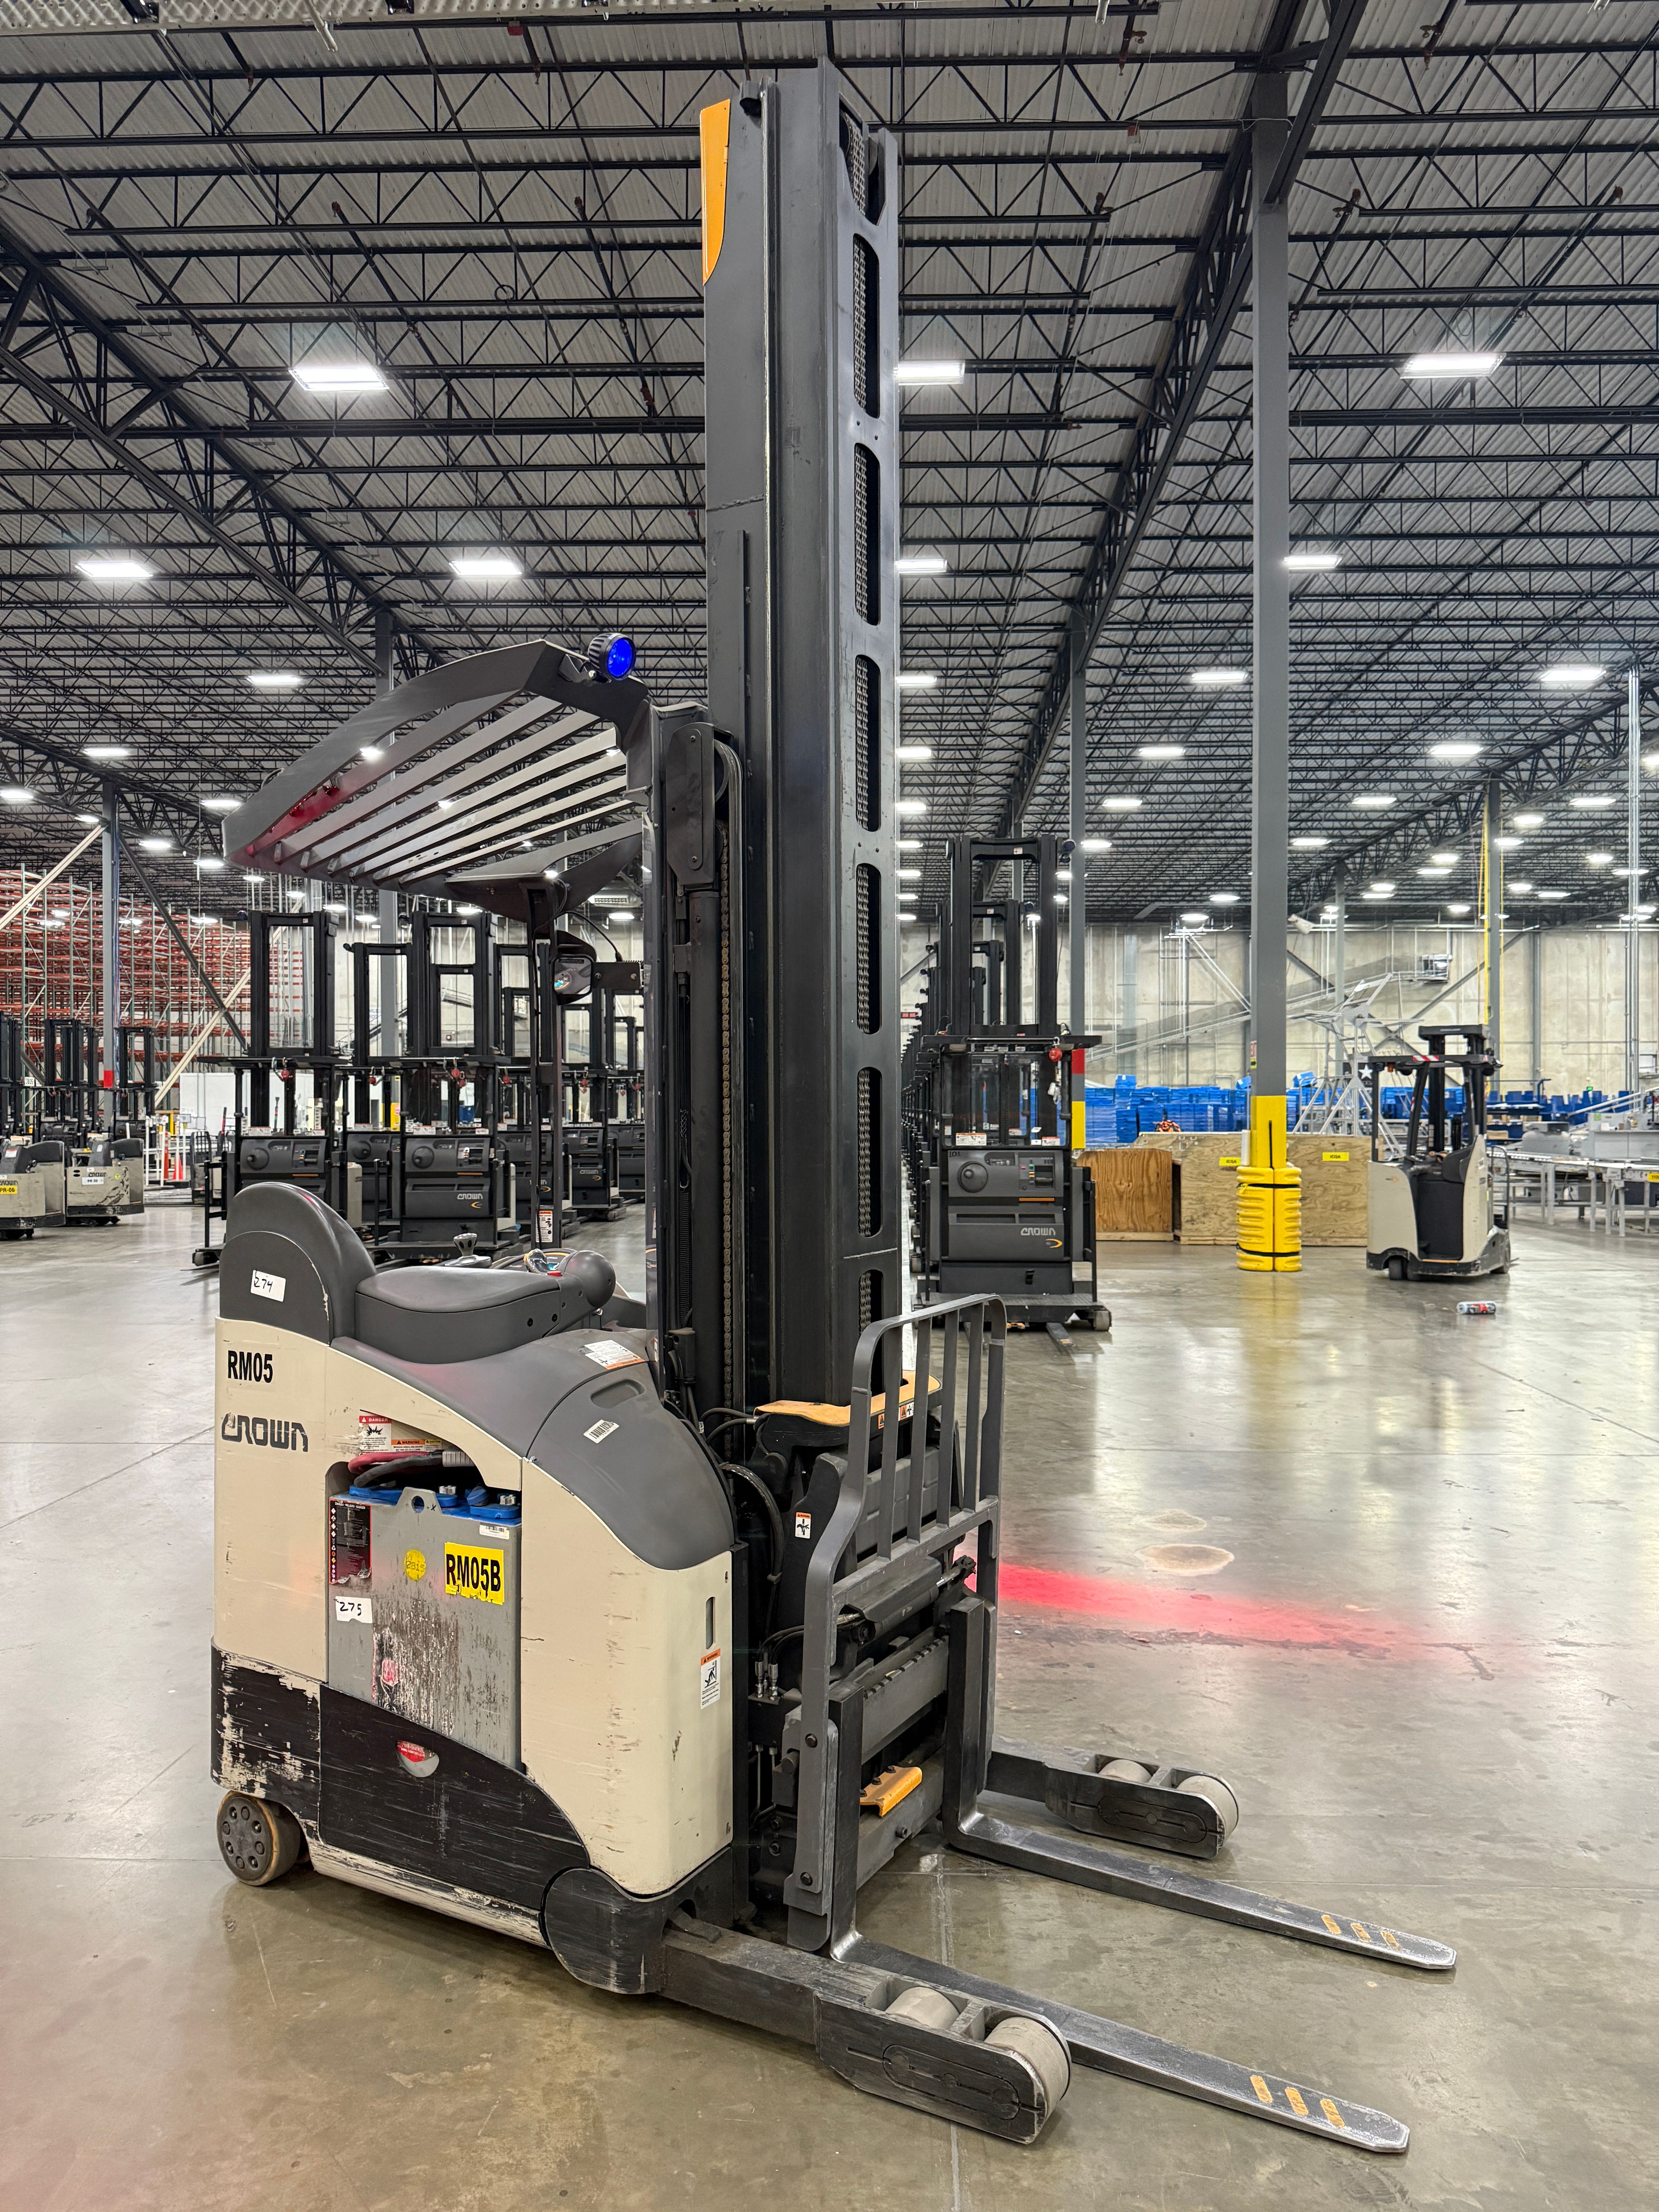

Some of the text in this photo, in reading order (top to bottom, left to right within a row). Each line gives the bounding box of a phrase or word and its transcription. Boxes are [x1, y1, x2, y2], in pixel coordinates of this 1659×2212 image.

[1020, 1227, 1056, 1236] CROWN
[254, 1276, 273, 1293] 274
[228, 1350, 273, 1383] RM05
[222, 1413, 308, 1452] CROWN
[446, 1554, 501, 1592] RM05B
[340, 1602, 362, 1616] 275
